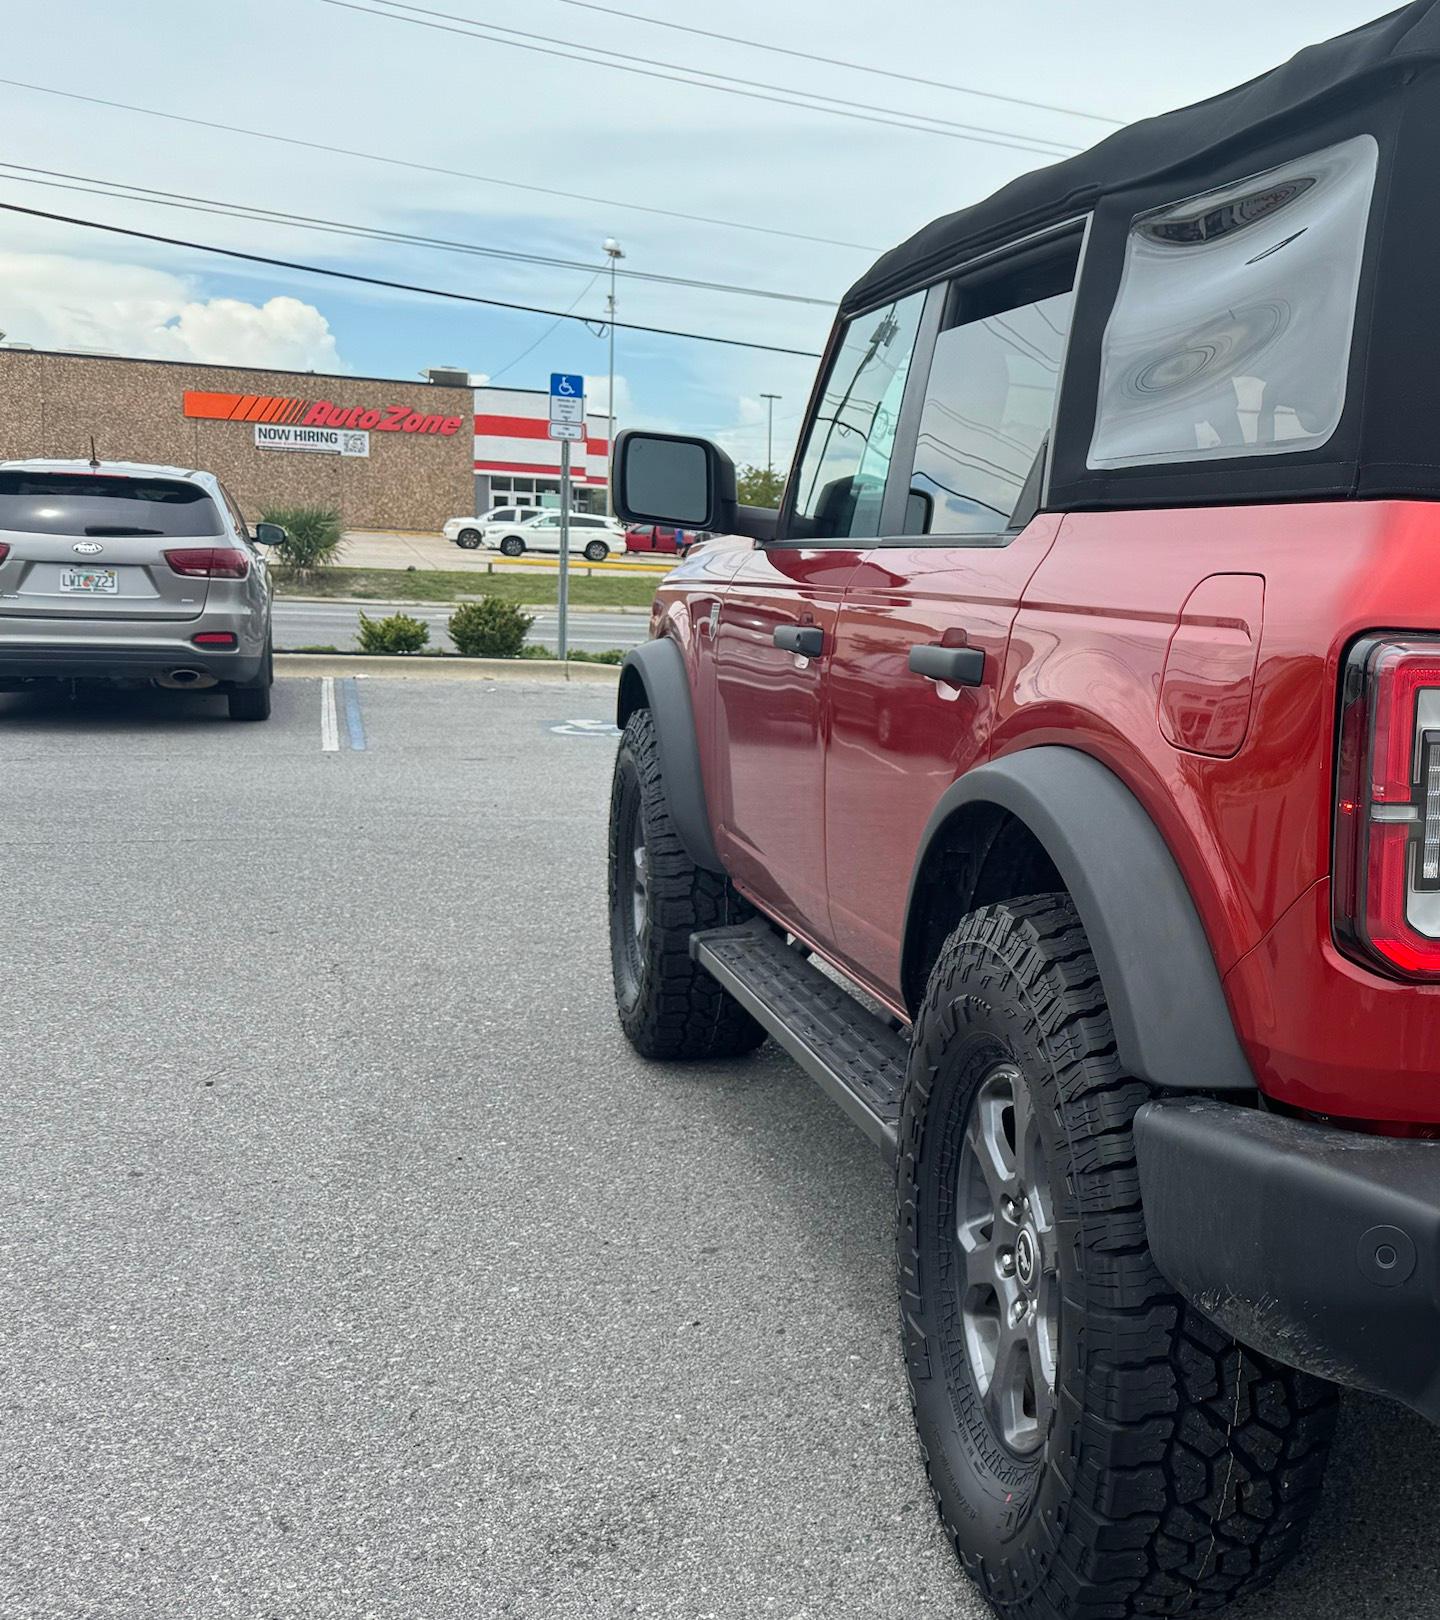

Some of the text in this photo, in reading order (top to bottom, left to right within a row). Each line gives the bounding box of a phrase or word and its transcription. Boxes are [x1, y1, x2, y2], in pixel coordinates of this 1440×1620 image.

[302, 400, 462, 437] AutoZone
[258, 427, 291, 442] NOW
[293, 429, 339, 445] HIRING
